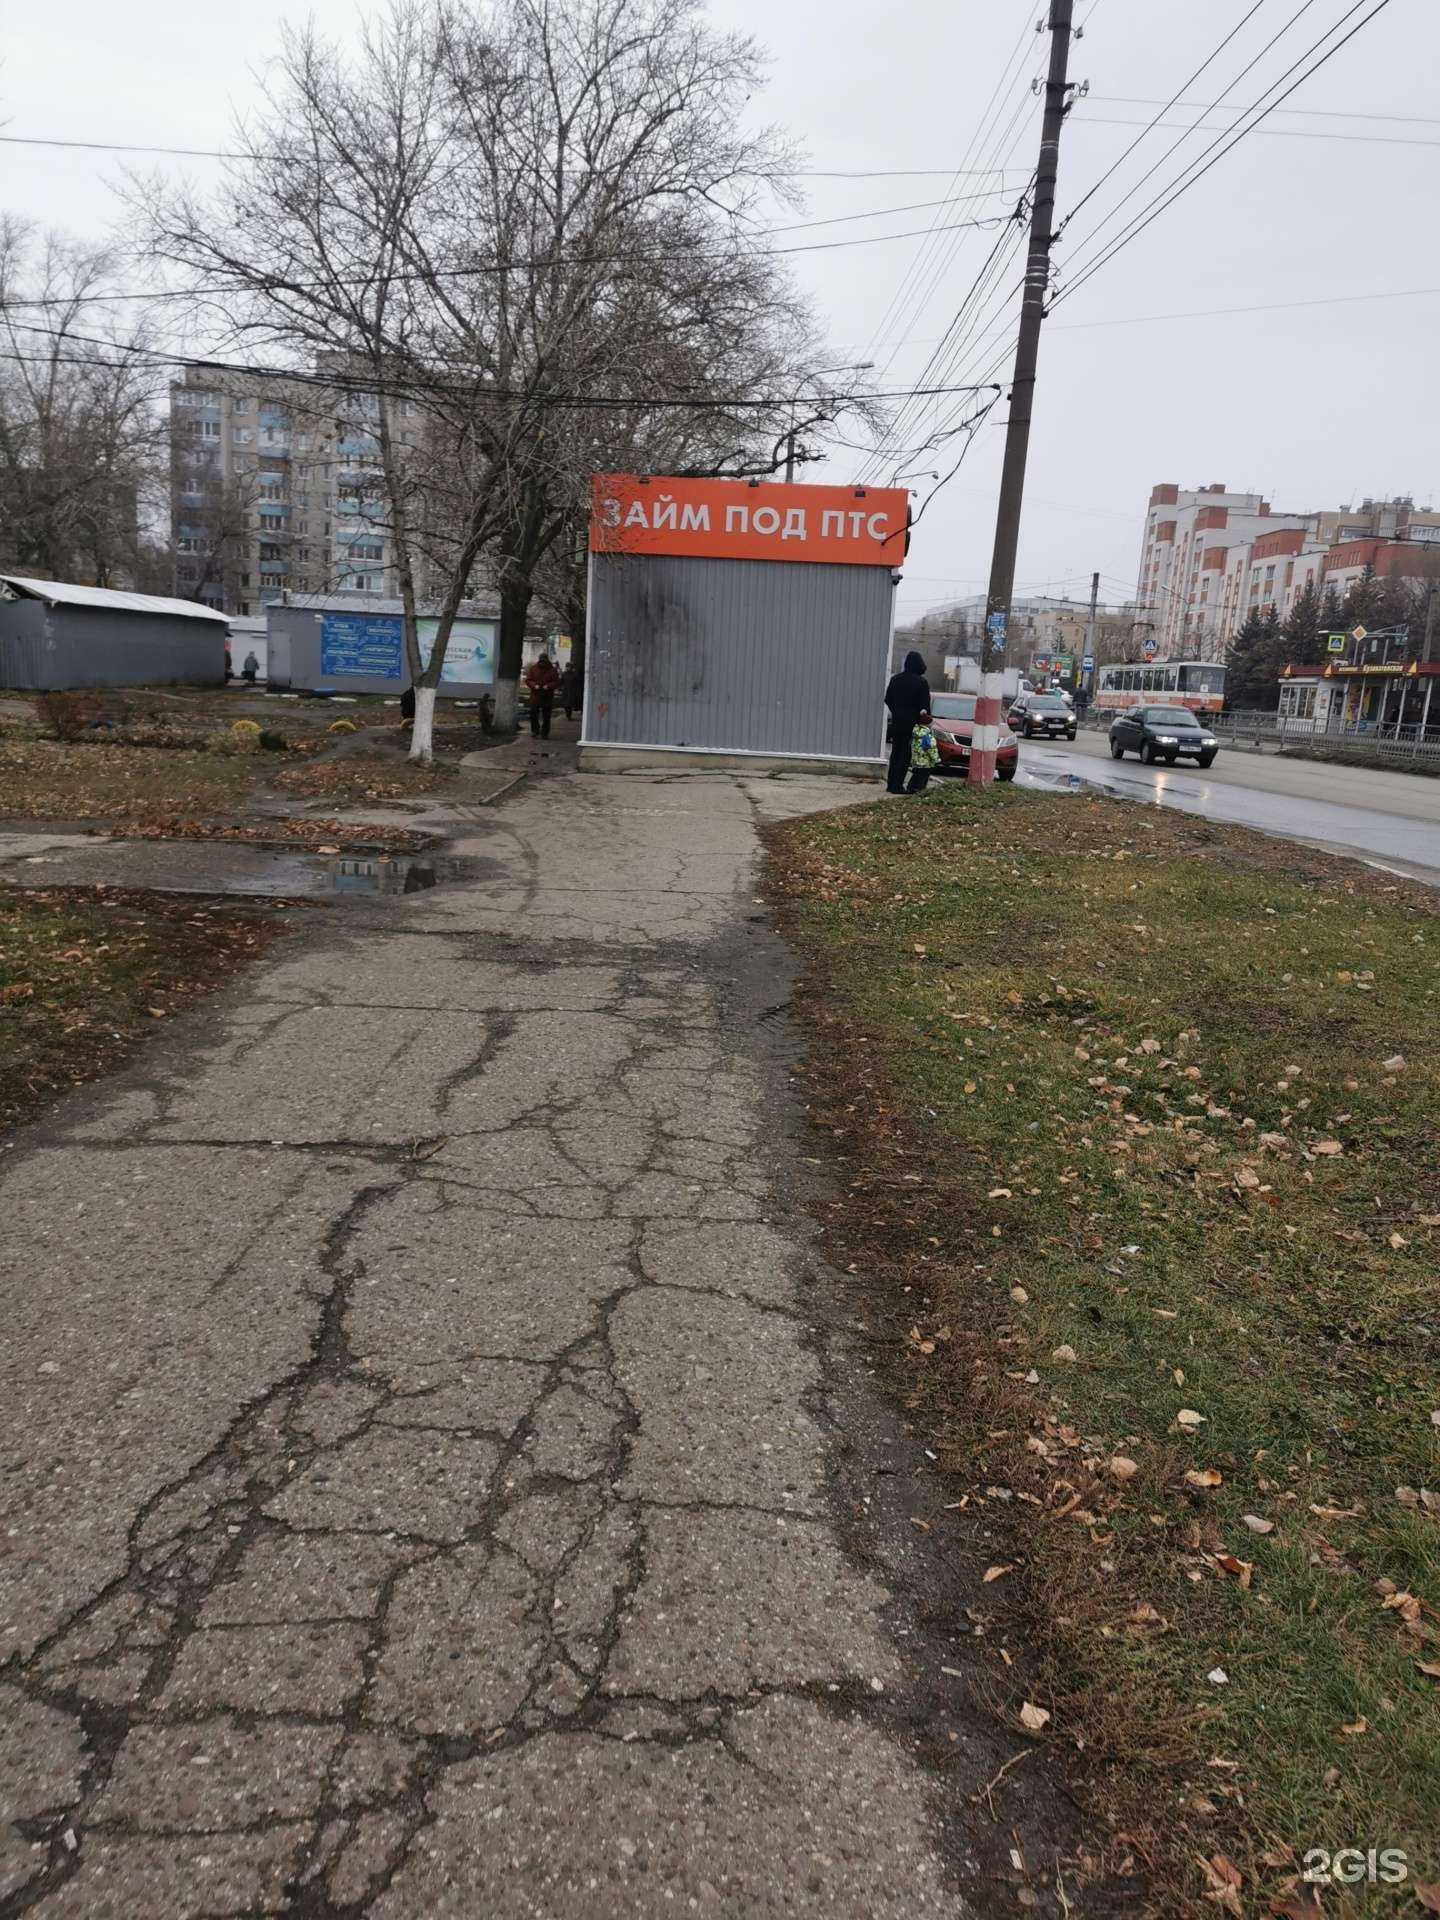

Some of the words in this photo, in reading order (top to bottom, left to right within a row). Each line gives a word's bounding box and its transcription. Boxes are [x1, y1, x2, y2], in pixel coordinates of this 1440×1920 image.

[602, 494, 711, 531] ЗАЙМ
[725, 505, 806, 541] ПОД
[821, 510, 889, 541] ПТС
